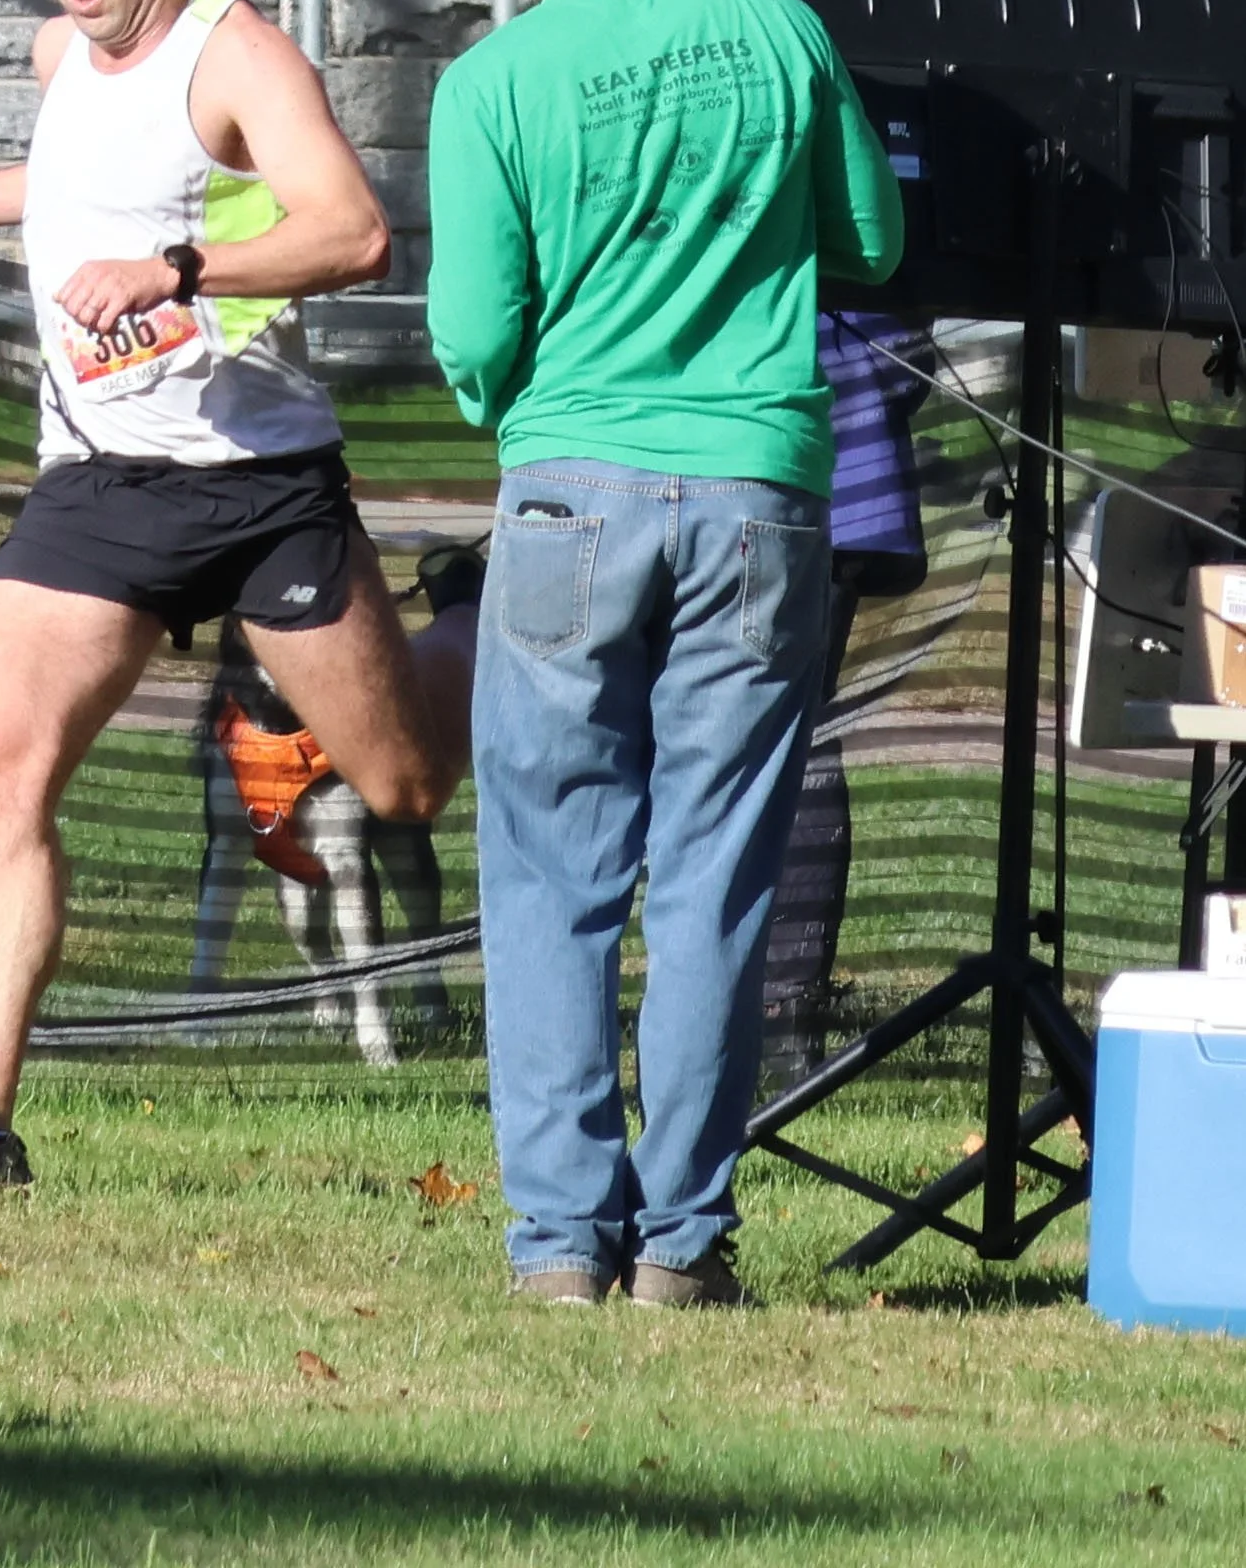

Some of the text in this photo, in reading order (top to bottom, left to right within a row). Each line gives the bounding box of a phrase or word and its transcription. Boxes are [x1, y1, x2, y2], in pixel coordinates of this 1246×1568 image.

[579, 37, 752, 99] LEAF PEEPERS
[586, 93, 626, 116] Half
[717, 65, 731, 78] &
[736, 60, 758, 76] 5K
